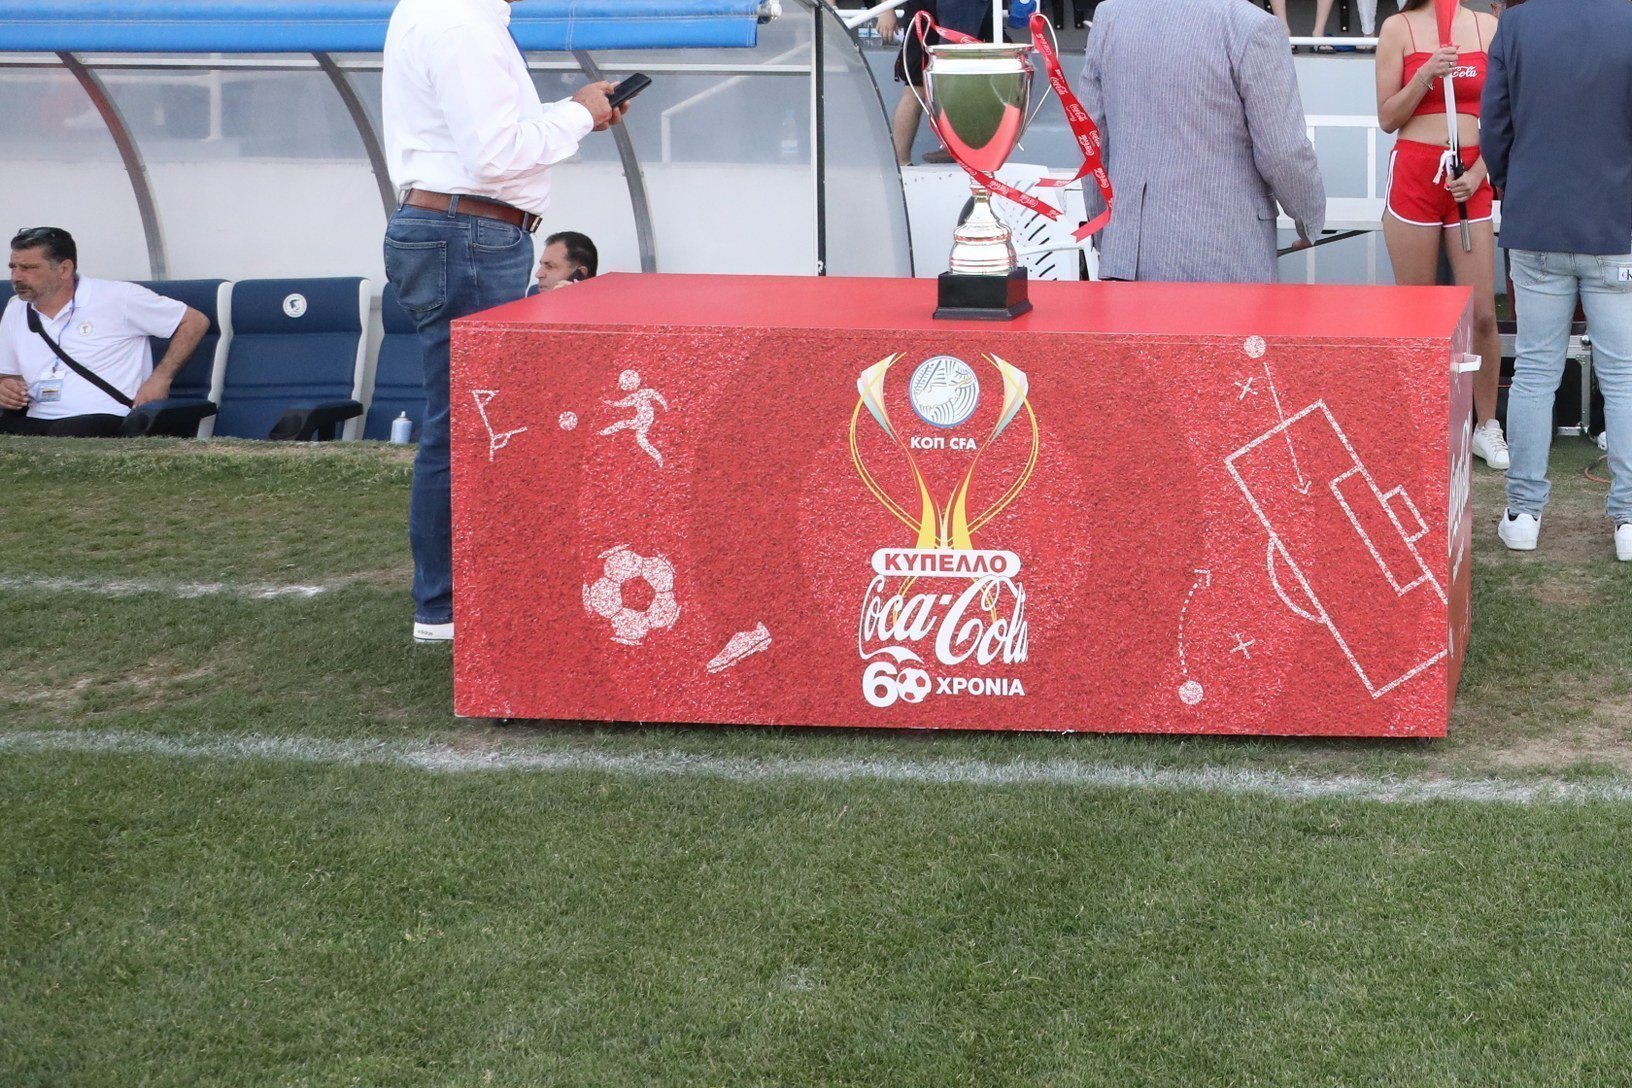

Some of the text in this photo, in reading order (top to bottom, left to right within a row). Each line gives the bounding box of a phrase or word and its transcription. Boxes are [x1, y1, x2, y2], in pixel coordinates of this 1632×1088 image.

[1451, 65, 1478, 78] Cola
[910, 436, 978, 451] ΚΟΠ CFA
[884, 553, 1008, 574] ΚΥΠΕΛΛΟ
[858, 574, 1029, 665] Coca-Cola
[935, 676, 1026, 697] ΧΡΟΝΙΑ
